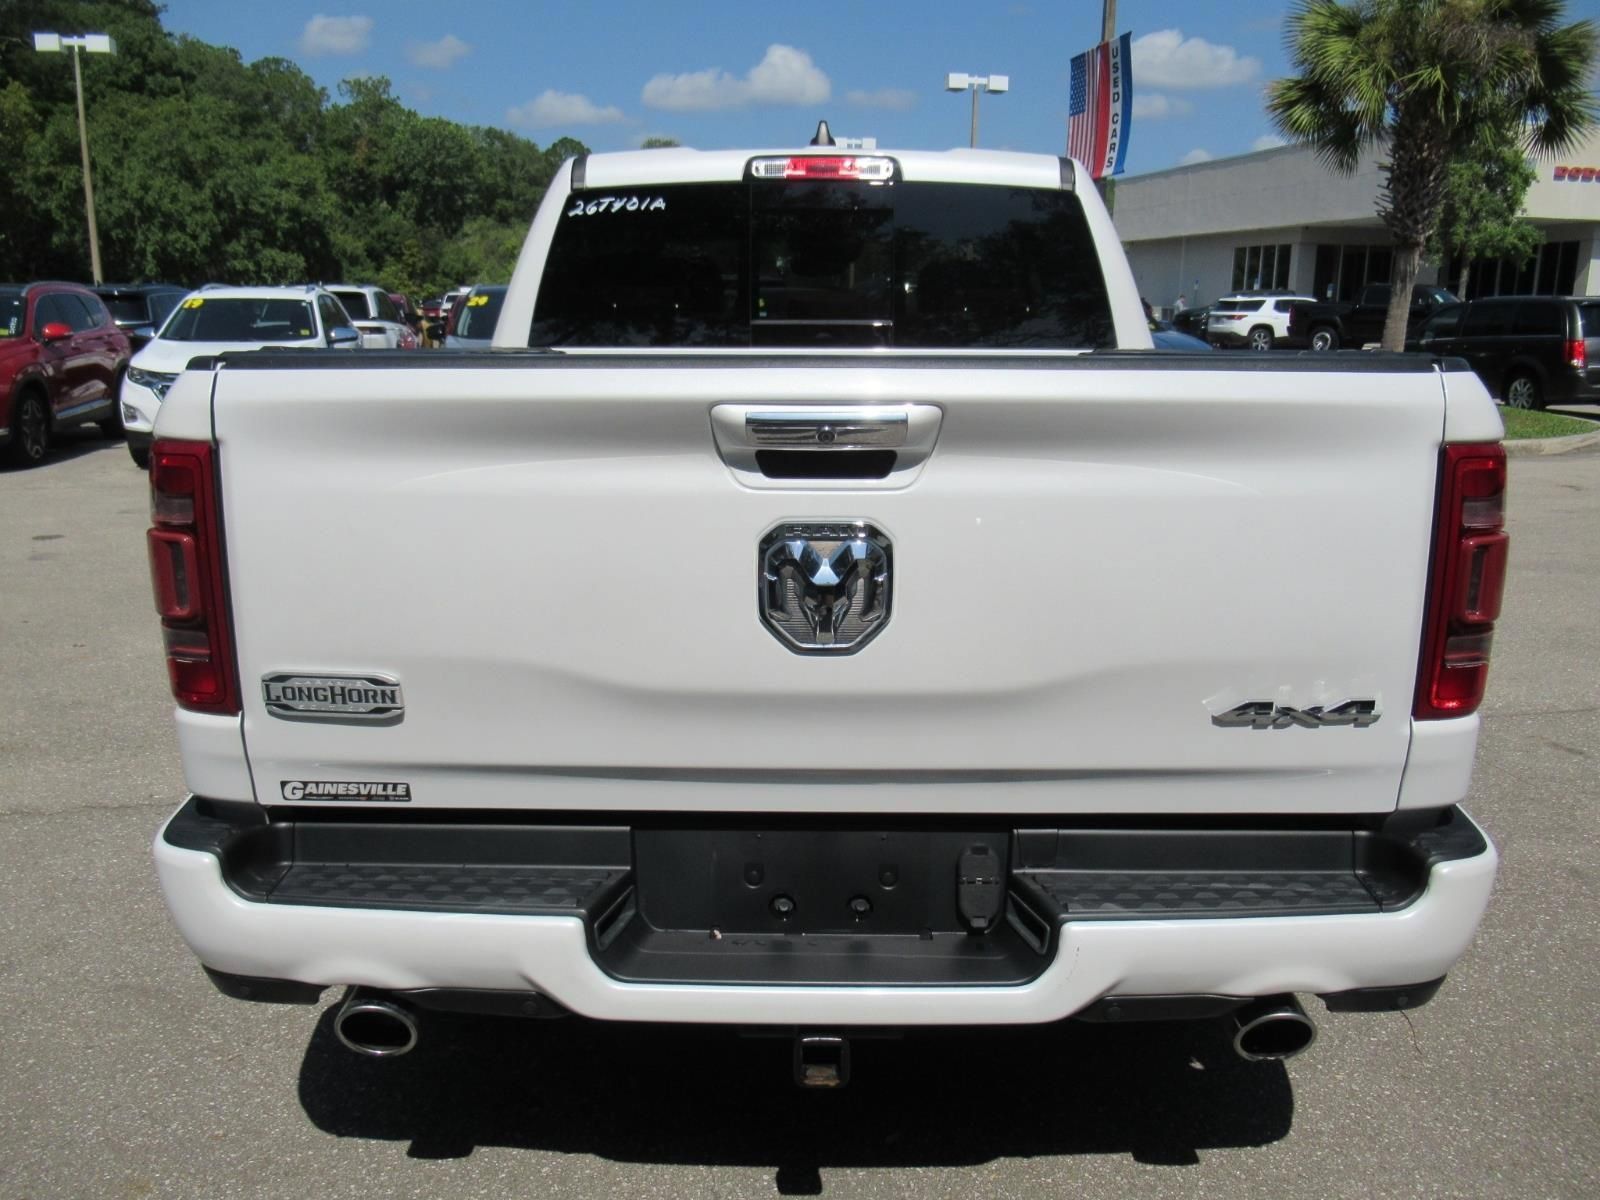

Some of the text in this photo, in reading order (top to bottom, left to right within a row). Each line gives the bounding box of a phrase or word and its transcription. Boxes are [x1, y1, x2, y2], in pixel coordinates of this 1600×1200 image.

[1106, 47, 1121, 168] USED CARS
[283, 781, 408, 800] GAINESVILLE
